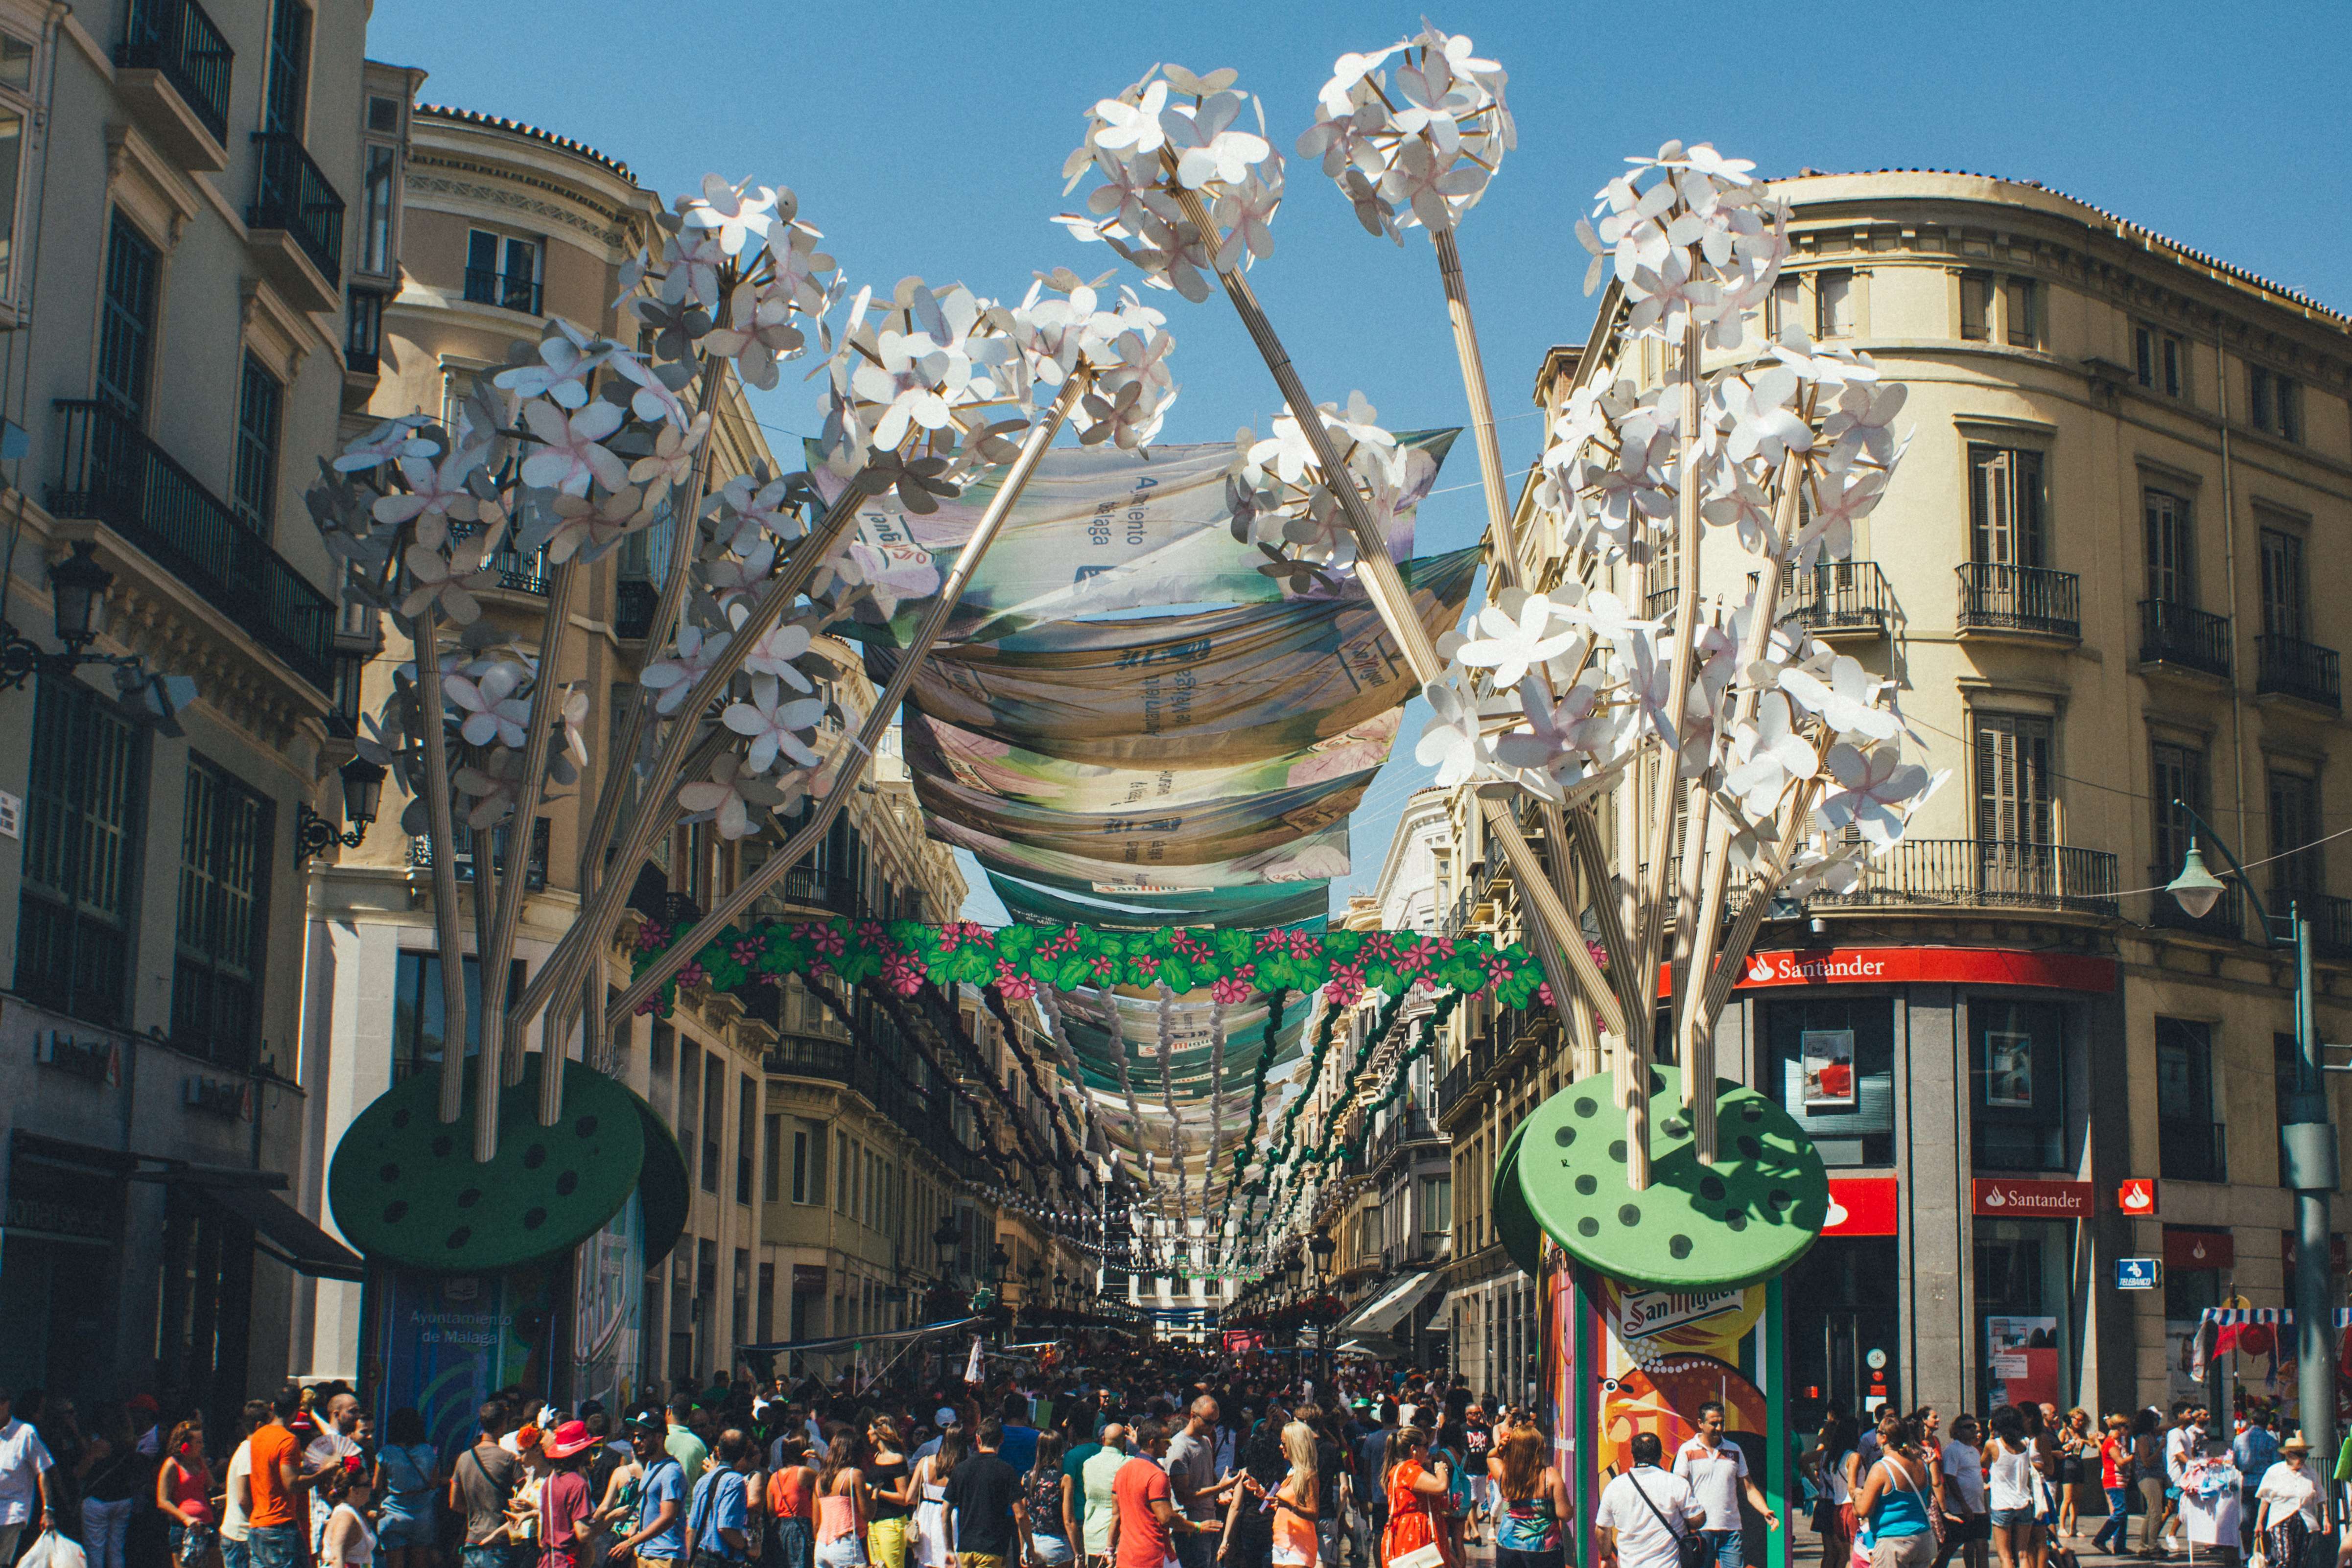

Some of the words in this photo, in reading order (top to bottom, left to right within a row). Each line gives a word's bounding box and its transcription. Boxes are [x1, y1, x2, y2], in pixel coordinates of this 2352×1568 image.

[1778, 955, 1884, 979] Santander
[2008, 1190, 2081, 1208] Santander
[411, 1310, 512, 1326] Ayuntamiento
[1624, 1299, 1668, 1332] San
[1665, 1289, 1735, 1314] Migu
[422, 1331, 440, 1342] de
[1871, 1353, 1882, 1361] ok
